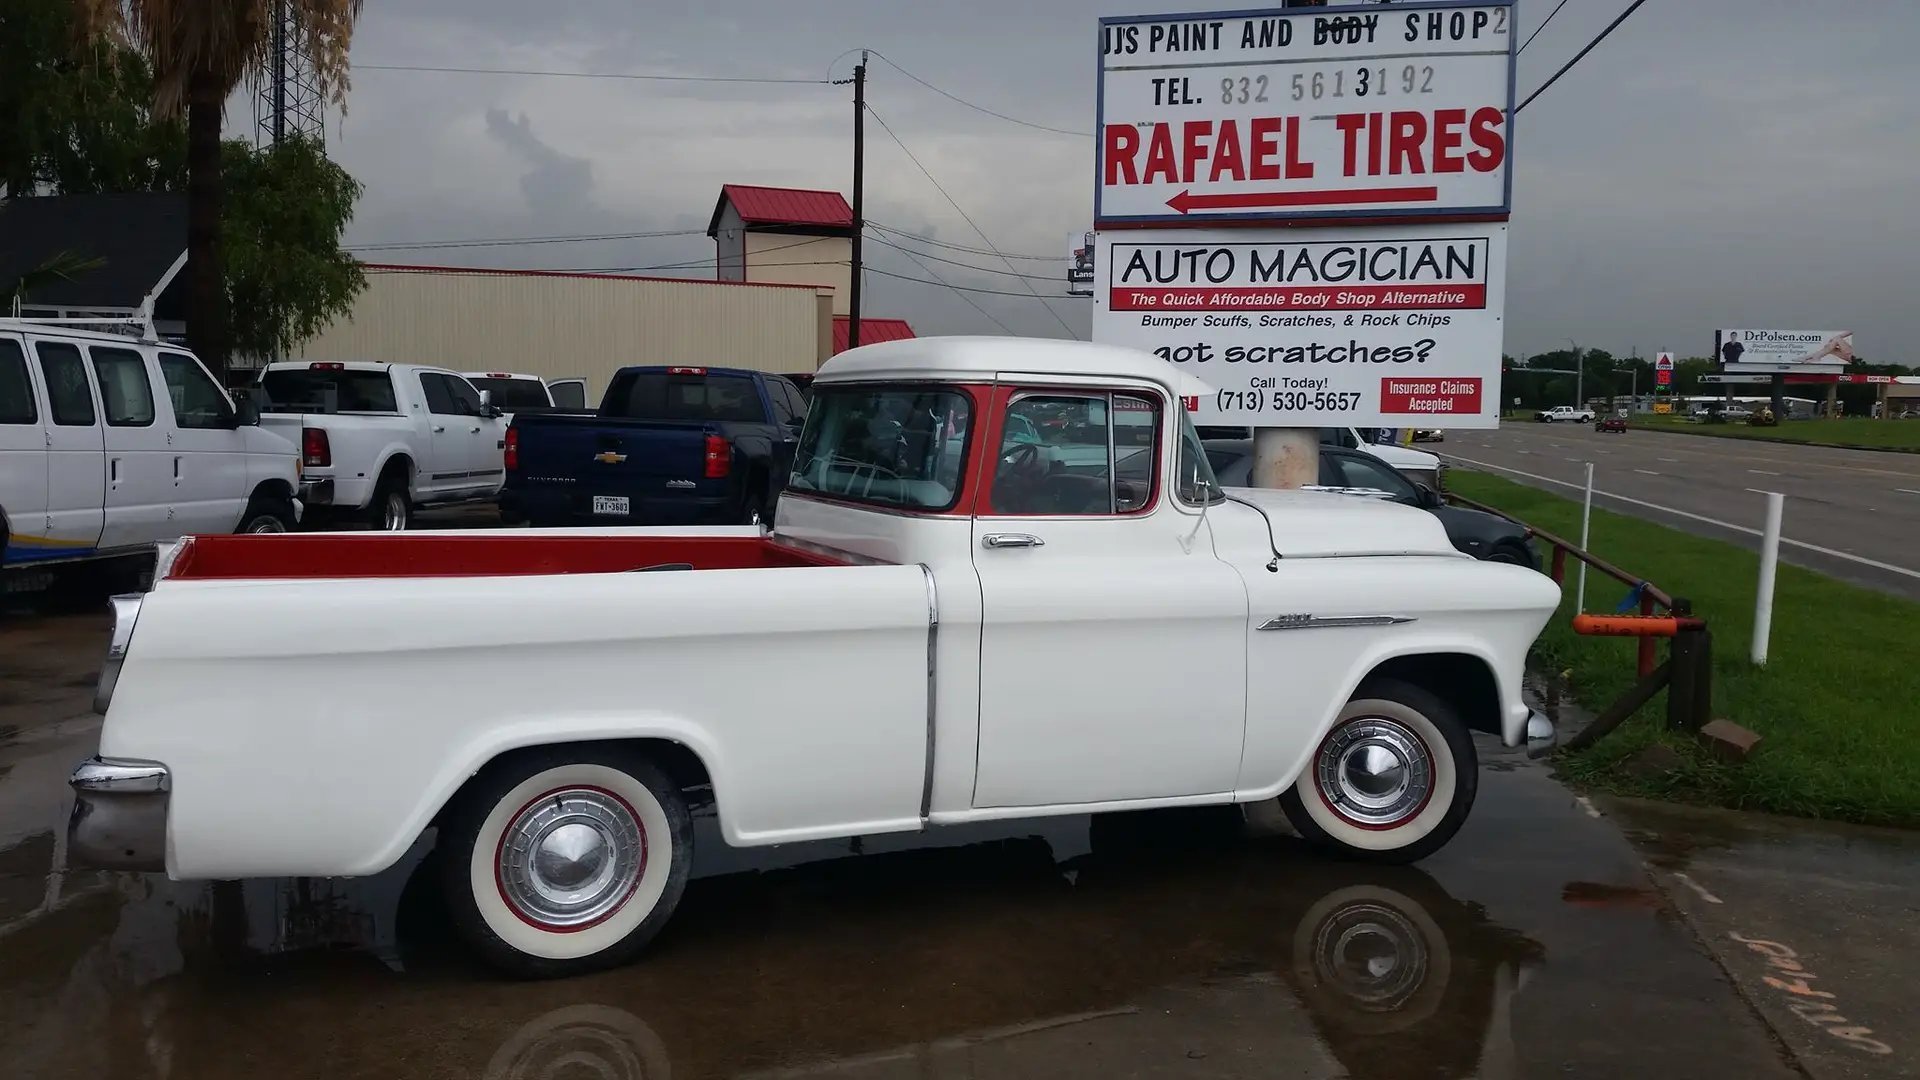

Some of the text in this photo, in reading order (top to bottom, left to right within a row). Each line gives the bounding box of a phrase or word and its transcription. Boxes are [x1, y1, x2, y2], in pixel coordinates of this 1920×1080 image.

[1150, 22, 1223, 52] PAINT
[1241, 19, 1293, 49] AND
[1313, 14, 1379, 46] BODY
[1152, 77, 1202, 106] TEL.
[1221, 74, 1269, 105] 832
[1105, 106, 1505, 186] RAFAEL TIRES
[1121, 243, 1476, 284] AUTO MAGICIAN
[1130, 291, 1465, 307] The Quick Affordable Body Shop Alternative
[1141, 313, 1451, 329] Bumper Scuffs, Scratches, & Rock Chips
[1745, 331, 1822, 341] DrPolsen.com
[1224, 338, 1436, 363] scratches?
[1250, 377, 1328, 390] Call Today!
[1389, 380, 1475, 395] Insurance Claims
[1217, 388, 1361, 412] (713) 530-5657
[1408, 397, 1453, 412] Accepted
